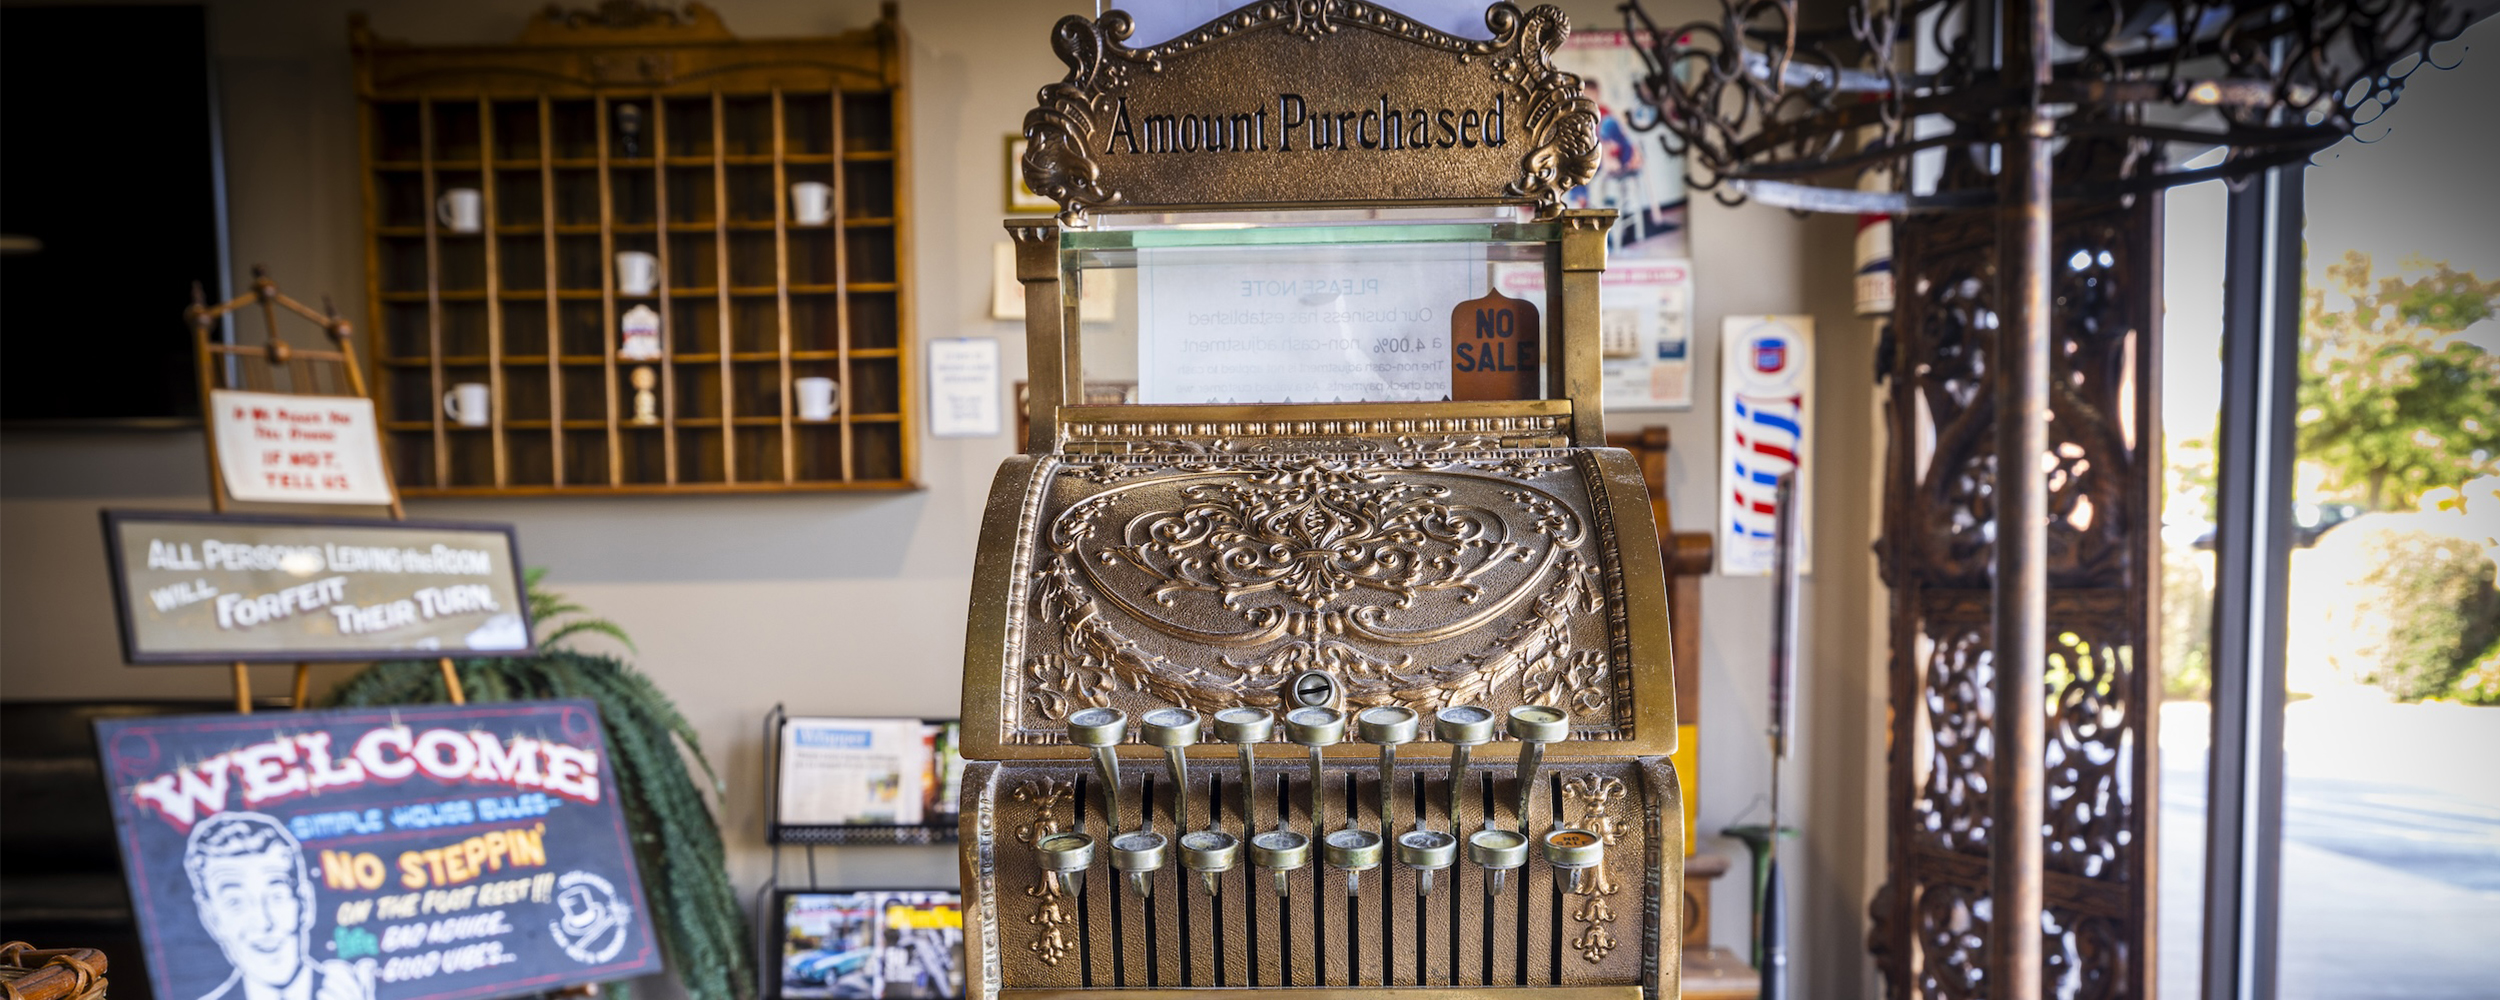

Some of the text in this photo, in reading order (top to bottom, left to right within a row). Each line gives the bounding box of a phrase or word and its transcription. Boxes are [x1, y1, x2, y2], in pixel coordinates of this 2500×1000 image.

[1105, 91, 1508, 155] Amount Purchased
[1475, 308, 1515, 339] NO
[1455, 341, 1536, 373] SALE
[148, 538, 202, 571] ALL
[137, 725, 599, 835] WELCOME
[321, 822, 547, 891] NO STEPPIN'
[376, 892, 422, 920] THE
[421, 885, 478, 915] FOOT
